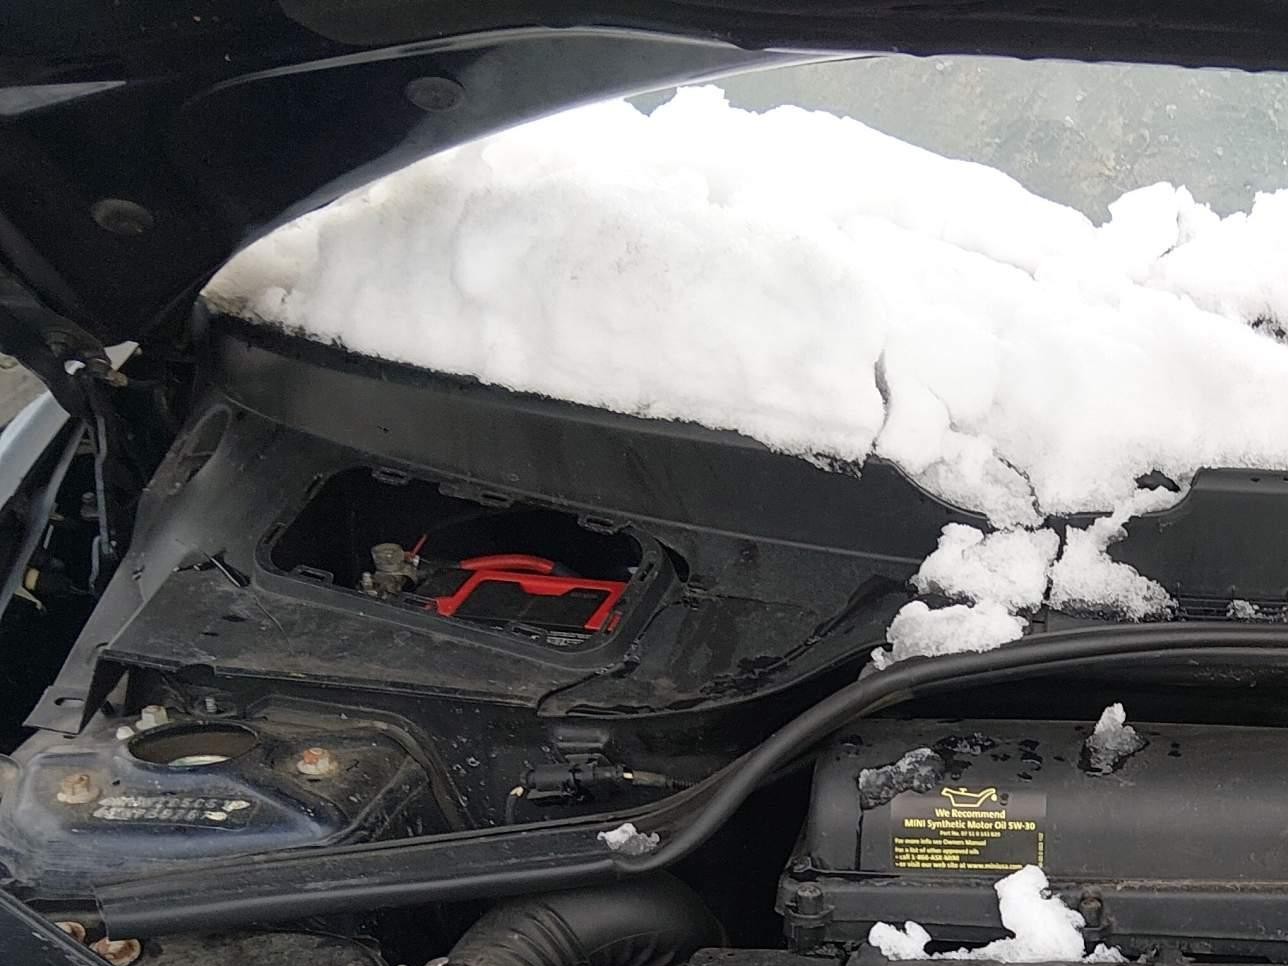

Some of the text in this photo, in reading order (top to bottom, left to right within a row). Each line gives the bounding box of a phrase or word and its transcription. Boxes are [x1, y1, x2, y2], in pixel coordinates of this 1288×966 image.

[935, 808, 1006, 819] We Recommend
[904, 818, 1036, 831] MINI Synthetic Motor Oil 5W-30
